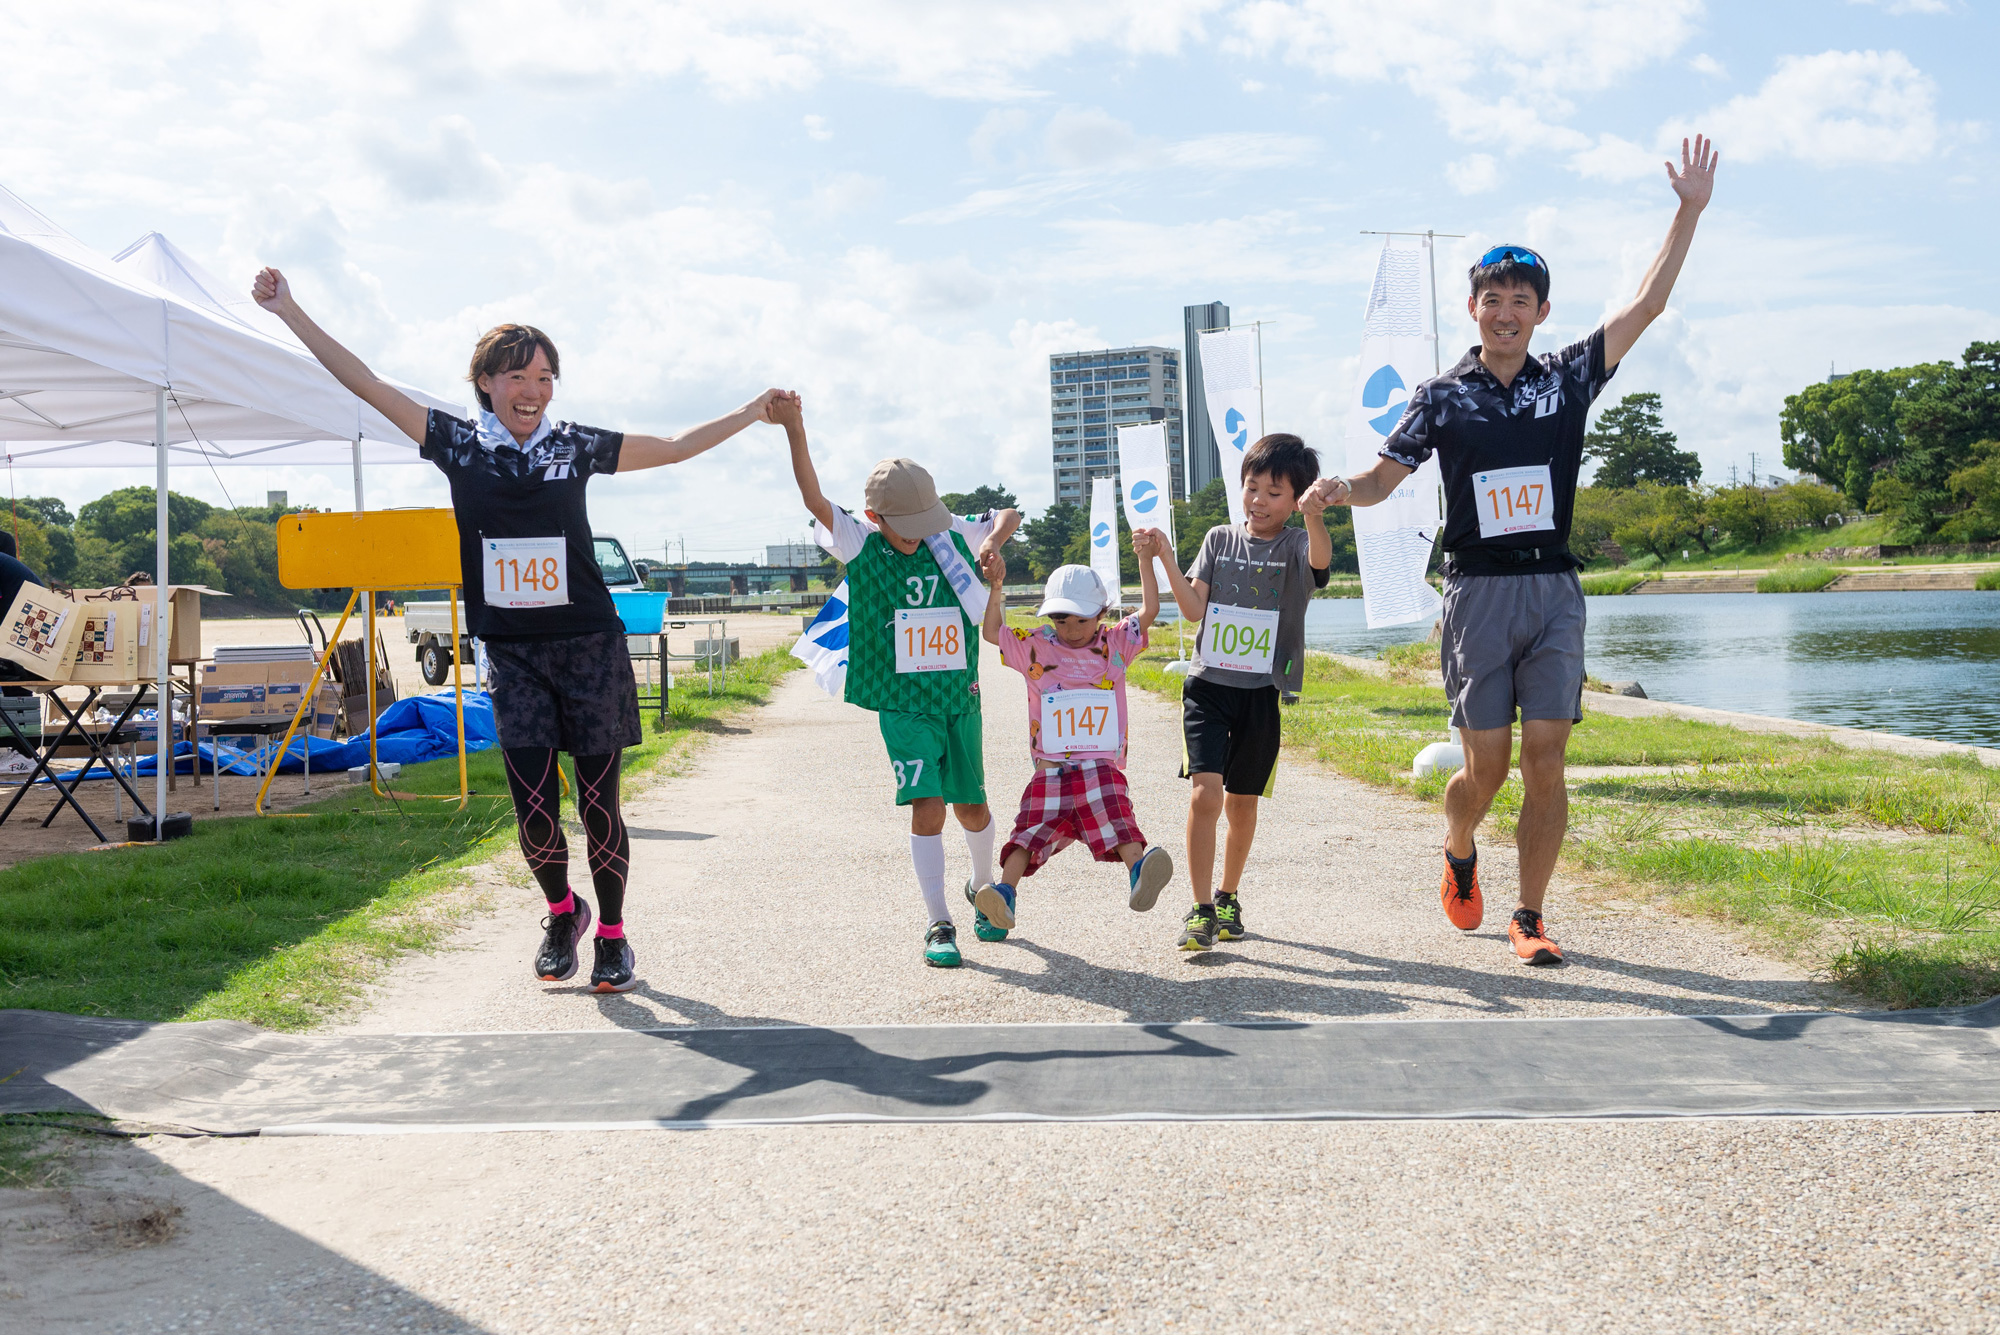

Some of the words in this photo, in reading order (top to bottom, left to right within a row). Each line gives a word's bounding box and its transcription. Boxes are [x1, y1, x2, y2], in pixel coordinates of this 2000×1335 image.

[1487, 484, 1543, 519] 1147
[495, 557, 559, 591] 1148
[906, 575, 939, 606] 37
[904, 624, 959, 657] 1148
[1212, 622, 1270, 658] 1094
[223, 691, 248, 699] AQUARIUS
[1053, 706, 1109, 737] 1147
[892, 758, 924, 790] 37
